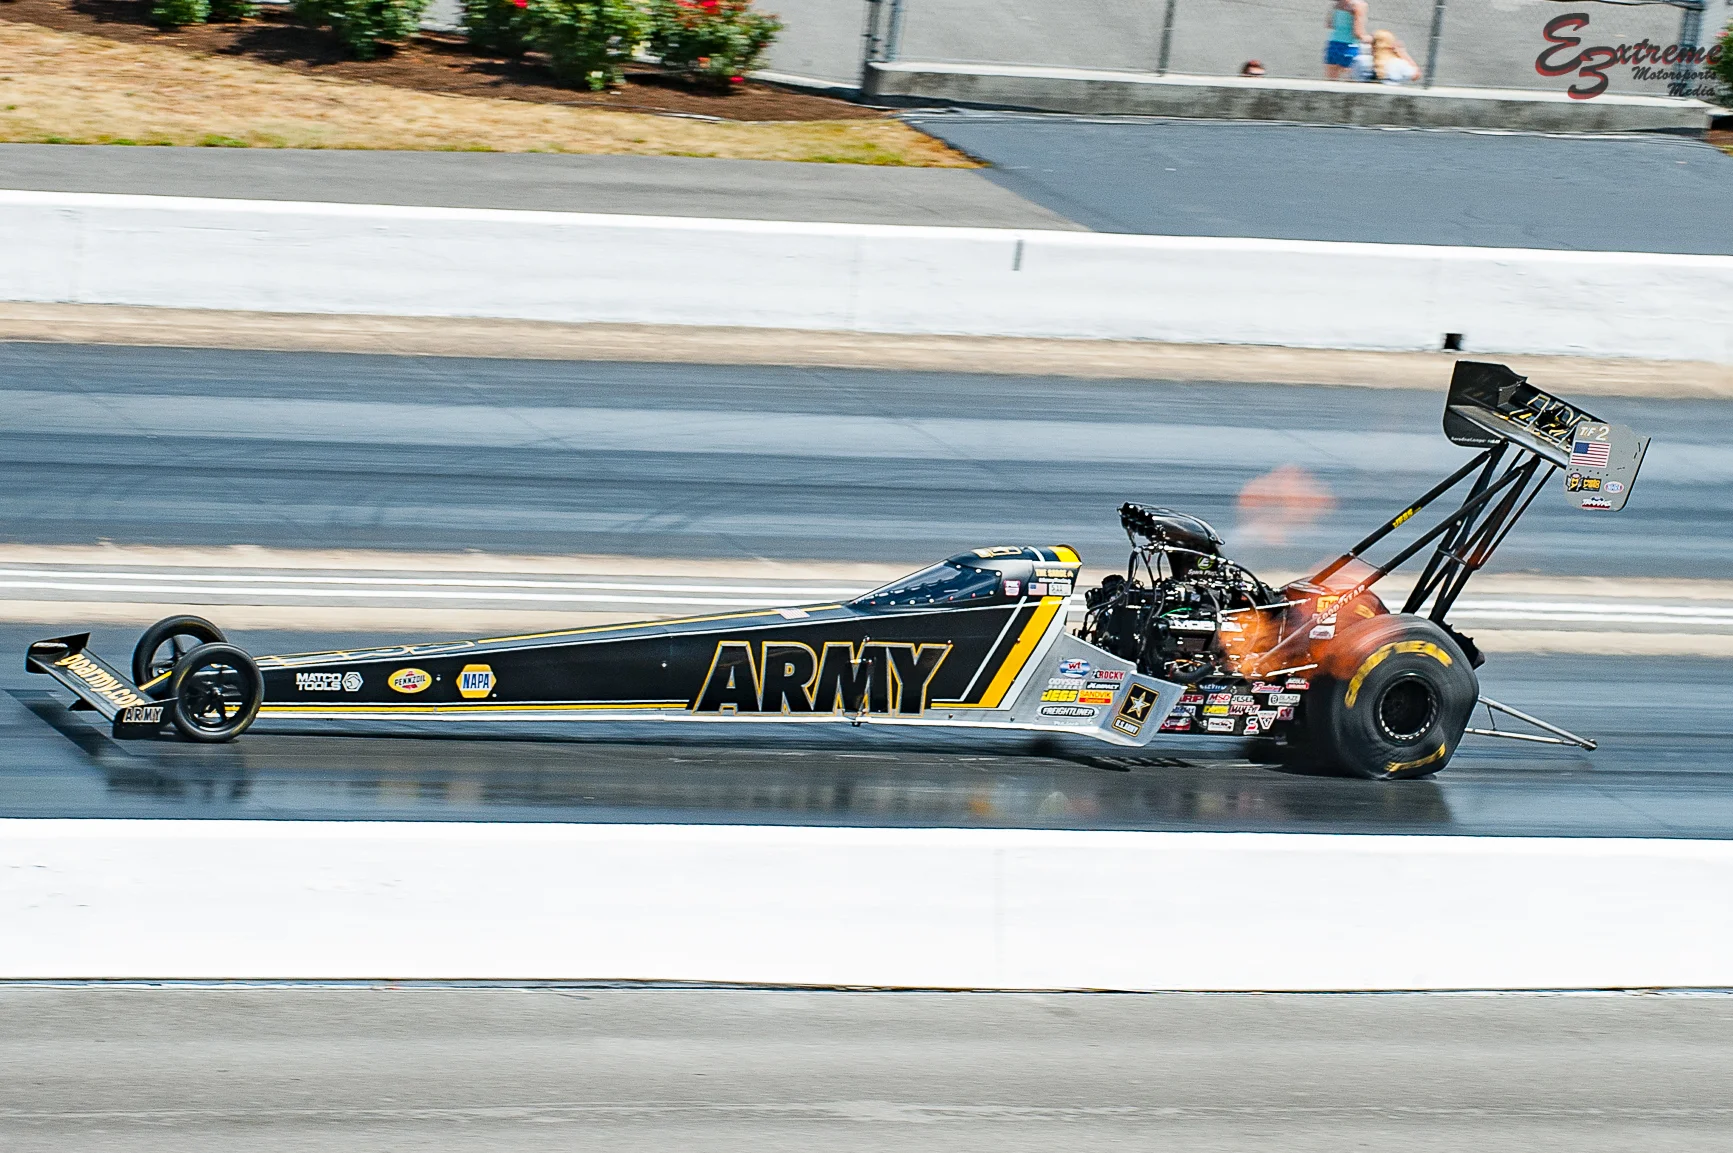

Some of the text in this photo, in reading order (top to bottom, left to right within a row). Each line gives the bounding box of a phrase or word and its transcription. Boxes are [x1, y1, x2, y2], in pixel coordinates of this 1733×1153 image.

[1596, 426, 1609, 440] 2
[296, 672, 342, 682] MATCO
[394, 674, 427, 687] PENNZOIL
[691, 640, 954, 718] ARMY
[1099, 670, 1125, 680] ROCKY
[297, 681, 342, 691] TOOLS
[462, 673, 490, 689] NAPA
[1048, 677, 1086, 686] ODYSSEY
[1041, 689, 1079, 702] JEGS
[1080, 690, 1111, 698] SANDVIK
[123, 706, 164, 723] ARMY
[1042, 707, 1094, 716] FREIGHTLINER
